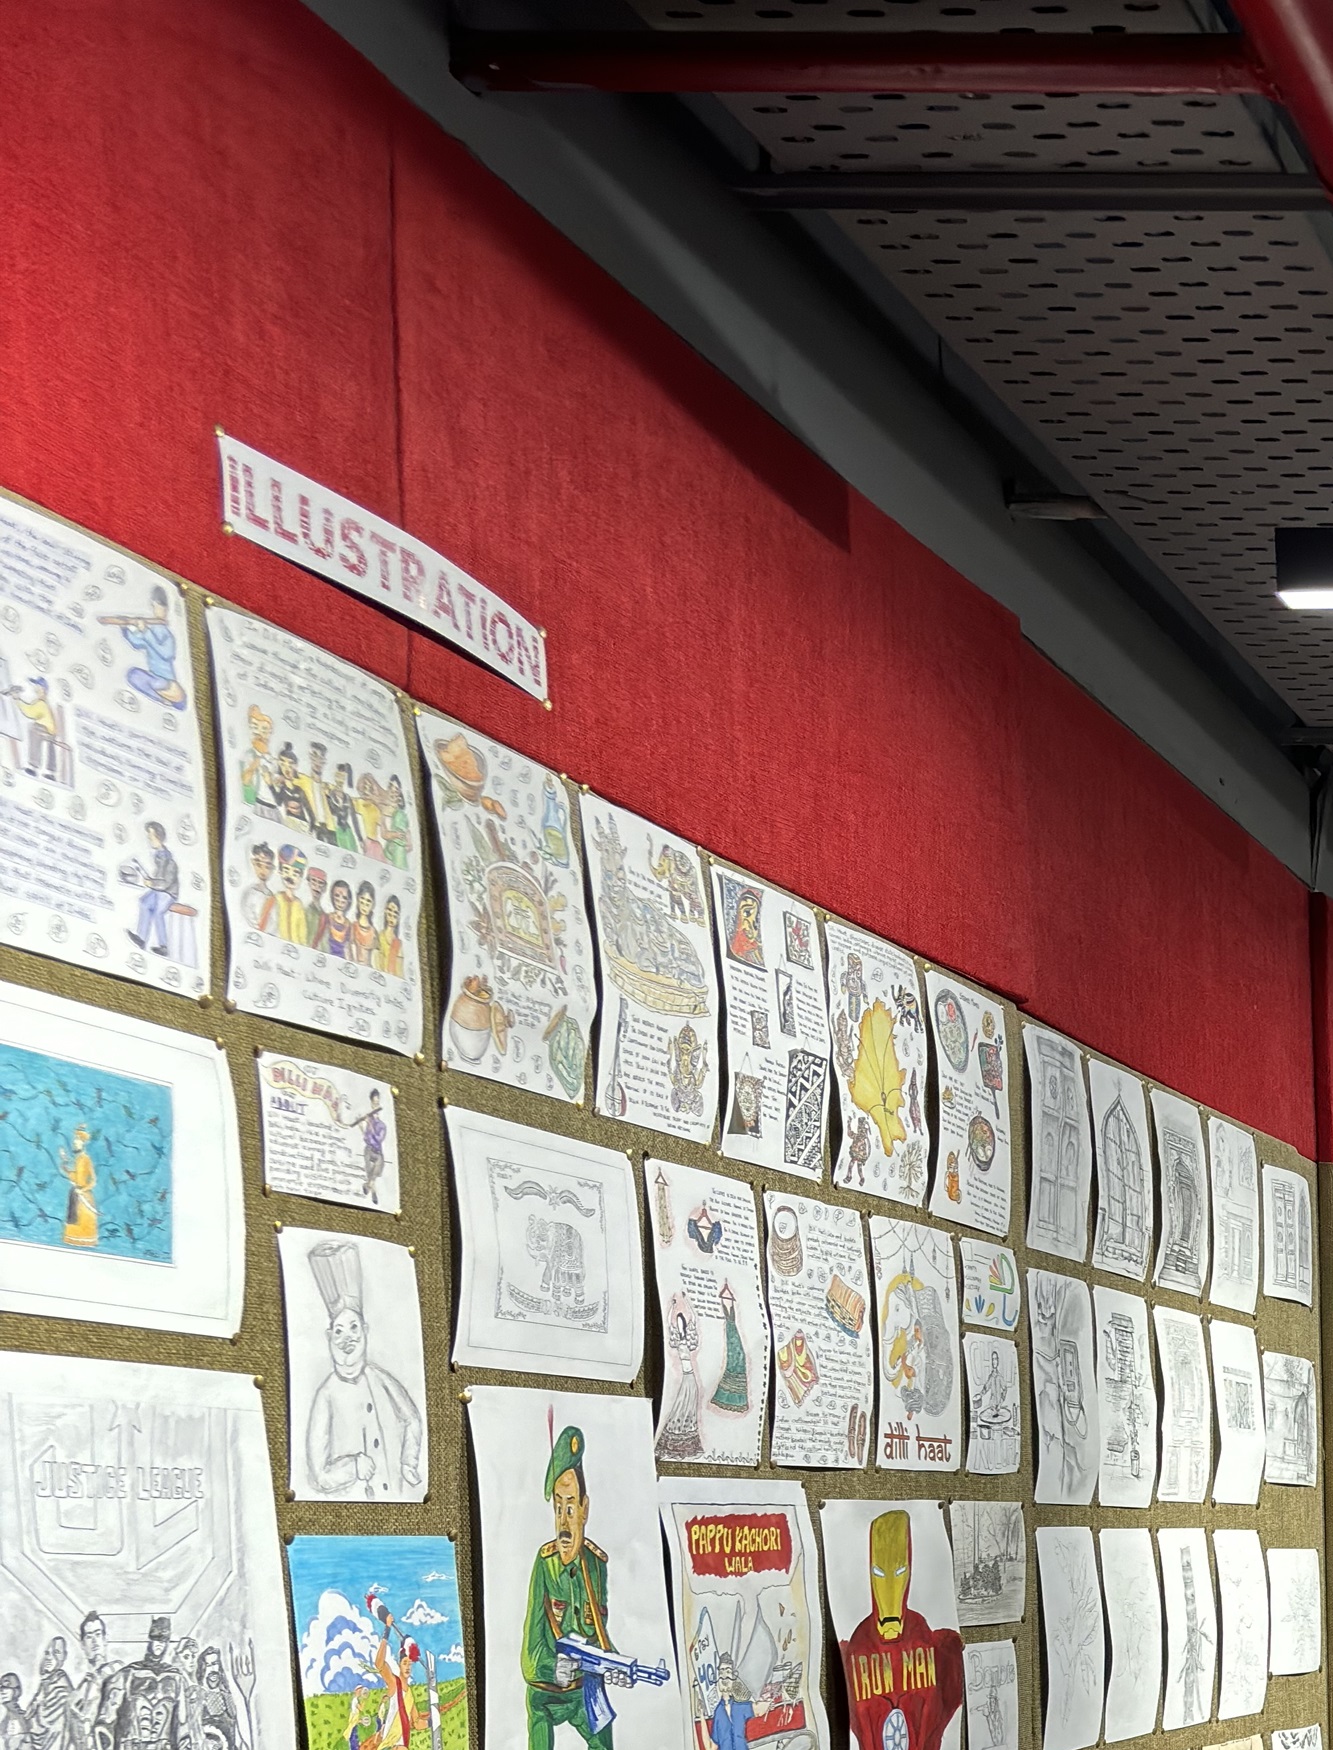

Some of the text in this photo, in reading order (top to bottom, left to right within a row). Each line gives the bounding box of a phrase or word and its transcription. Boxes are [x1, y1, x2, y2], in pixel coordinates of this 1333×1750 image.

[227, 455, 542, 687] ILLUSTRATION
[884, 1422, 910, 1460] dilli
[916, 1424, 953, 1463] haat
[36, 1461, 204, 1500] JUSTICE LEAGUE
[691, 1524, 781, 1555] PAPPU KACHORI
[724, 1556, 754, 1573] WALA
[850, 1646, 937, 1702] IRON MAN
